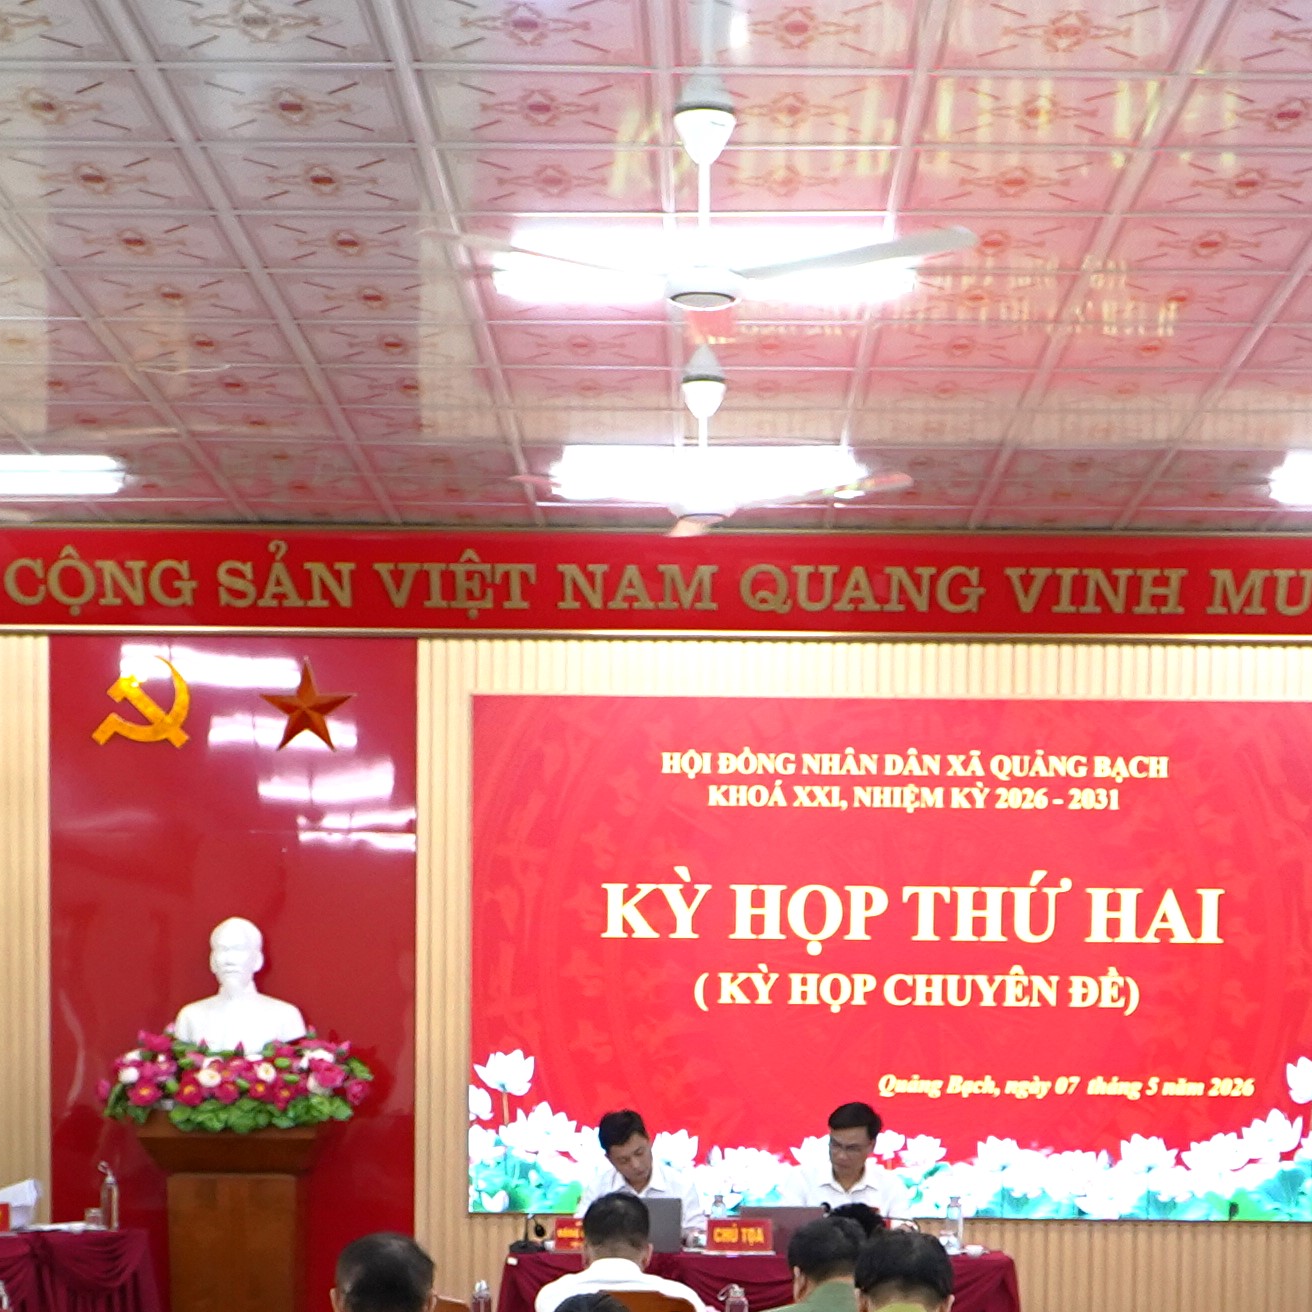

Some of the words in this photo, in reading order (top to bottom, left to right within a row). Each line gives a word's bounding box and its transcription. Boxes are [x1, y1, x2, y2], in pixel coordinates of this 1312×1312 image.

[4, 544, 198, 616] CỘNG
[217, 538, 356, 608] SẢN
[375, 549, 538, 619] VIỆT
[556, 562, 721, 611] NAM
[738, 564, 988, 616] QUANG
[1003, 567, 1188, 615] VINH
[661, 749, 712, 780] HỘI
[801, 746, 879, 776] NHÂN
[883, 747, 941, 777] DÂN
[946, 749, 986, 777] XÃ
[989, 749, 1089, 781] QUẢNG
[1093, 755, 1170, 783] BẠCH
[707, 779, 788, 808] KHOÁ
[792, 785, 849, 811] XXI,
[853, 783, 945, 814] NHIỆM
[950, 781, 991, 810] KỲ
[994, 786, 1049, 810] 2026
[1067, 787, 1124, 811] 2031
[600, 865, 713, 940] KỲ
[728, 883, 890, 957] HỌP
[901, 869, 1074, 944] THỨ
[1084, 887, 1226, 945] HAI
[717, 963, 780, 1005] KỲ
[787, 972, 877, 1014] HỌP
[883, 964, 1060, 1008] CHUYÊN
[946, 1074, 1001, 1098] Bạch,
[1004, 1076, 1052, 1100] ngày
[1054, 1075, 1081, 1096] 07
[1086, 1075, 1143, 1101] tháng
[1145, 1077, 1160, 1096] 5
[1162, 1078, 1205, 1097] năm
[1207, 1077, 1256, 1098] 2026
